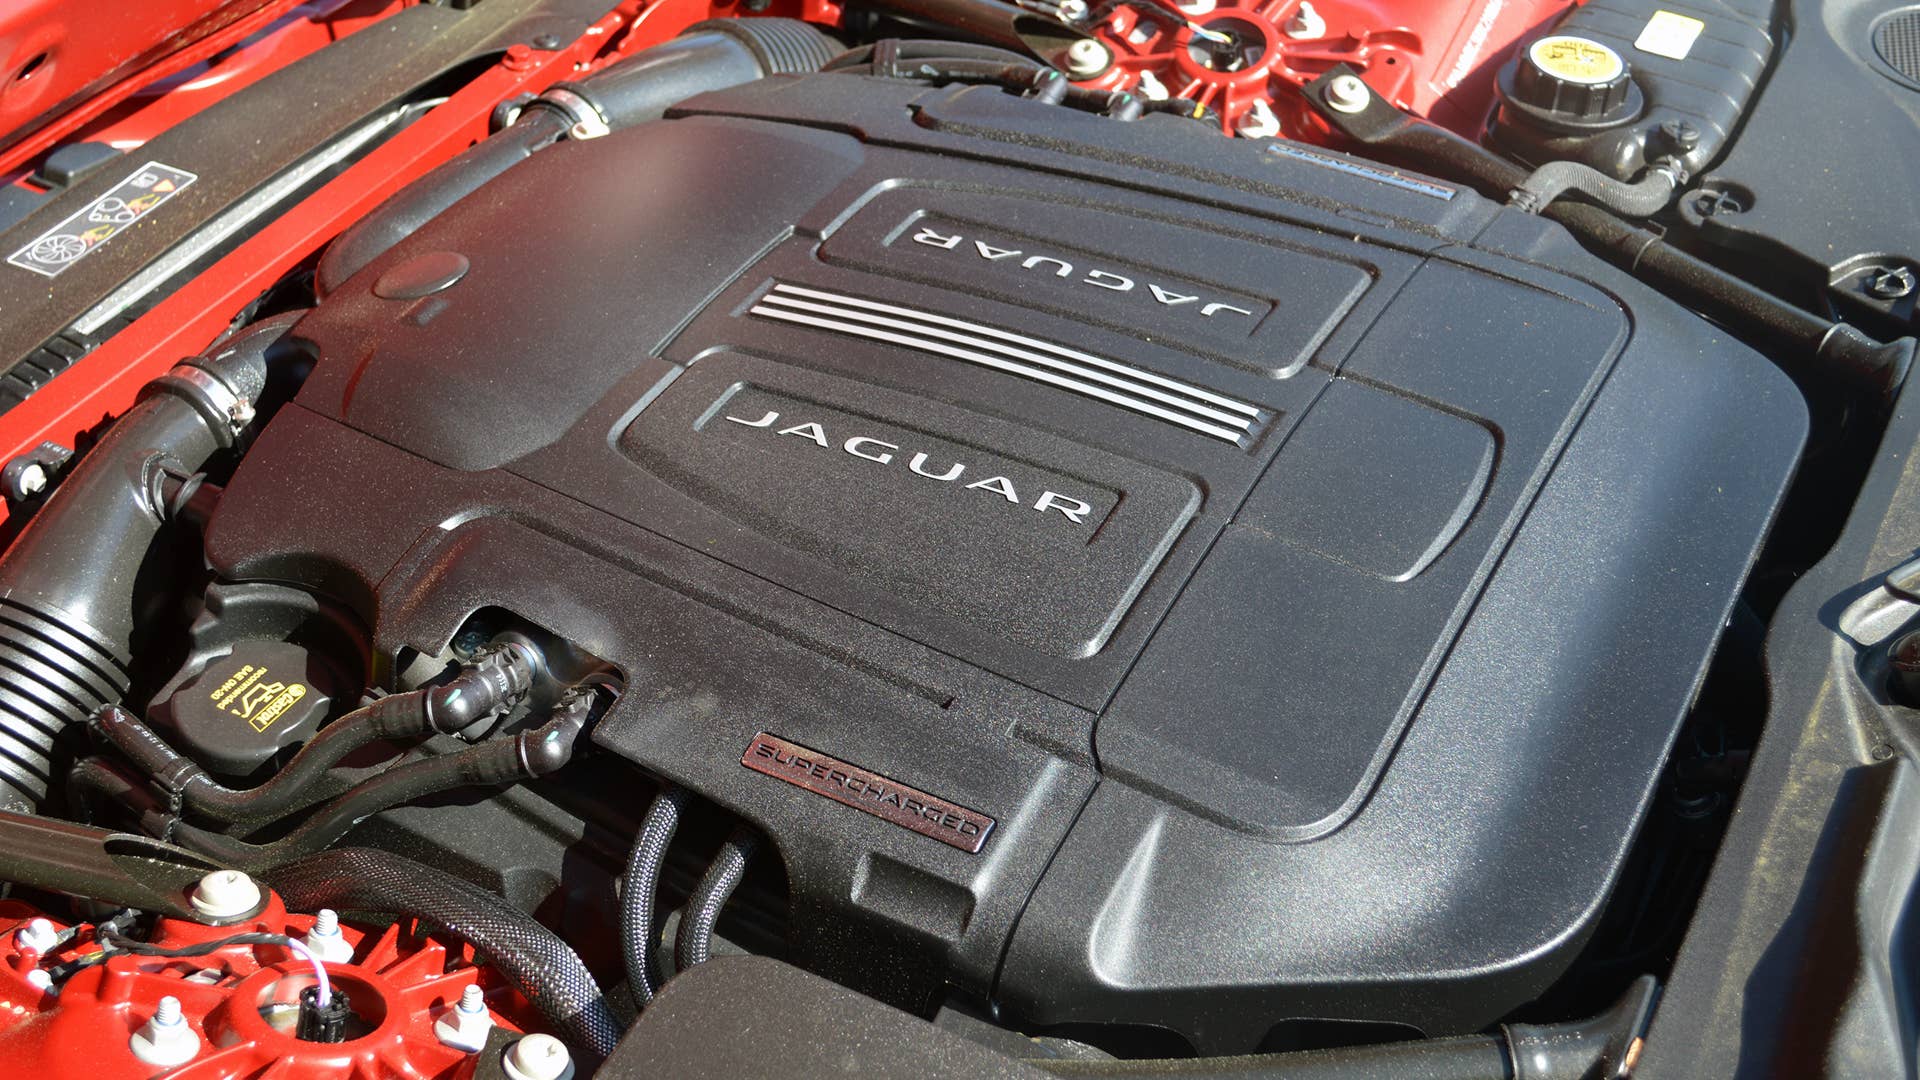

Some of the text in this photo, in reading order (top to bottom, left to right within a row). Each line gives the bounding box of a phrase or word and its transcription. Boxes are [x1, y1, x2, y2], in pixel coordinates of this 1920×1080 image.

[913, 227, 1251, 316] JAGUAR
[726, 411, 1091, 524] JAGUAR
[216, 666, 268, 710] recommended
[233, 664, 254, 681] SAE
[255, 693, 295, 725] Castrol
[755, 743, 980, 836] SUPERCHARGED
